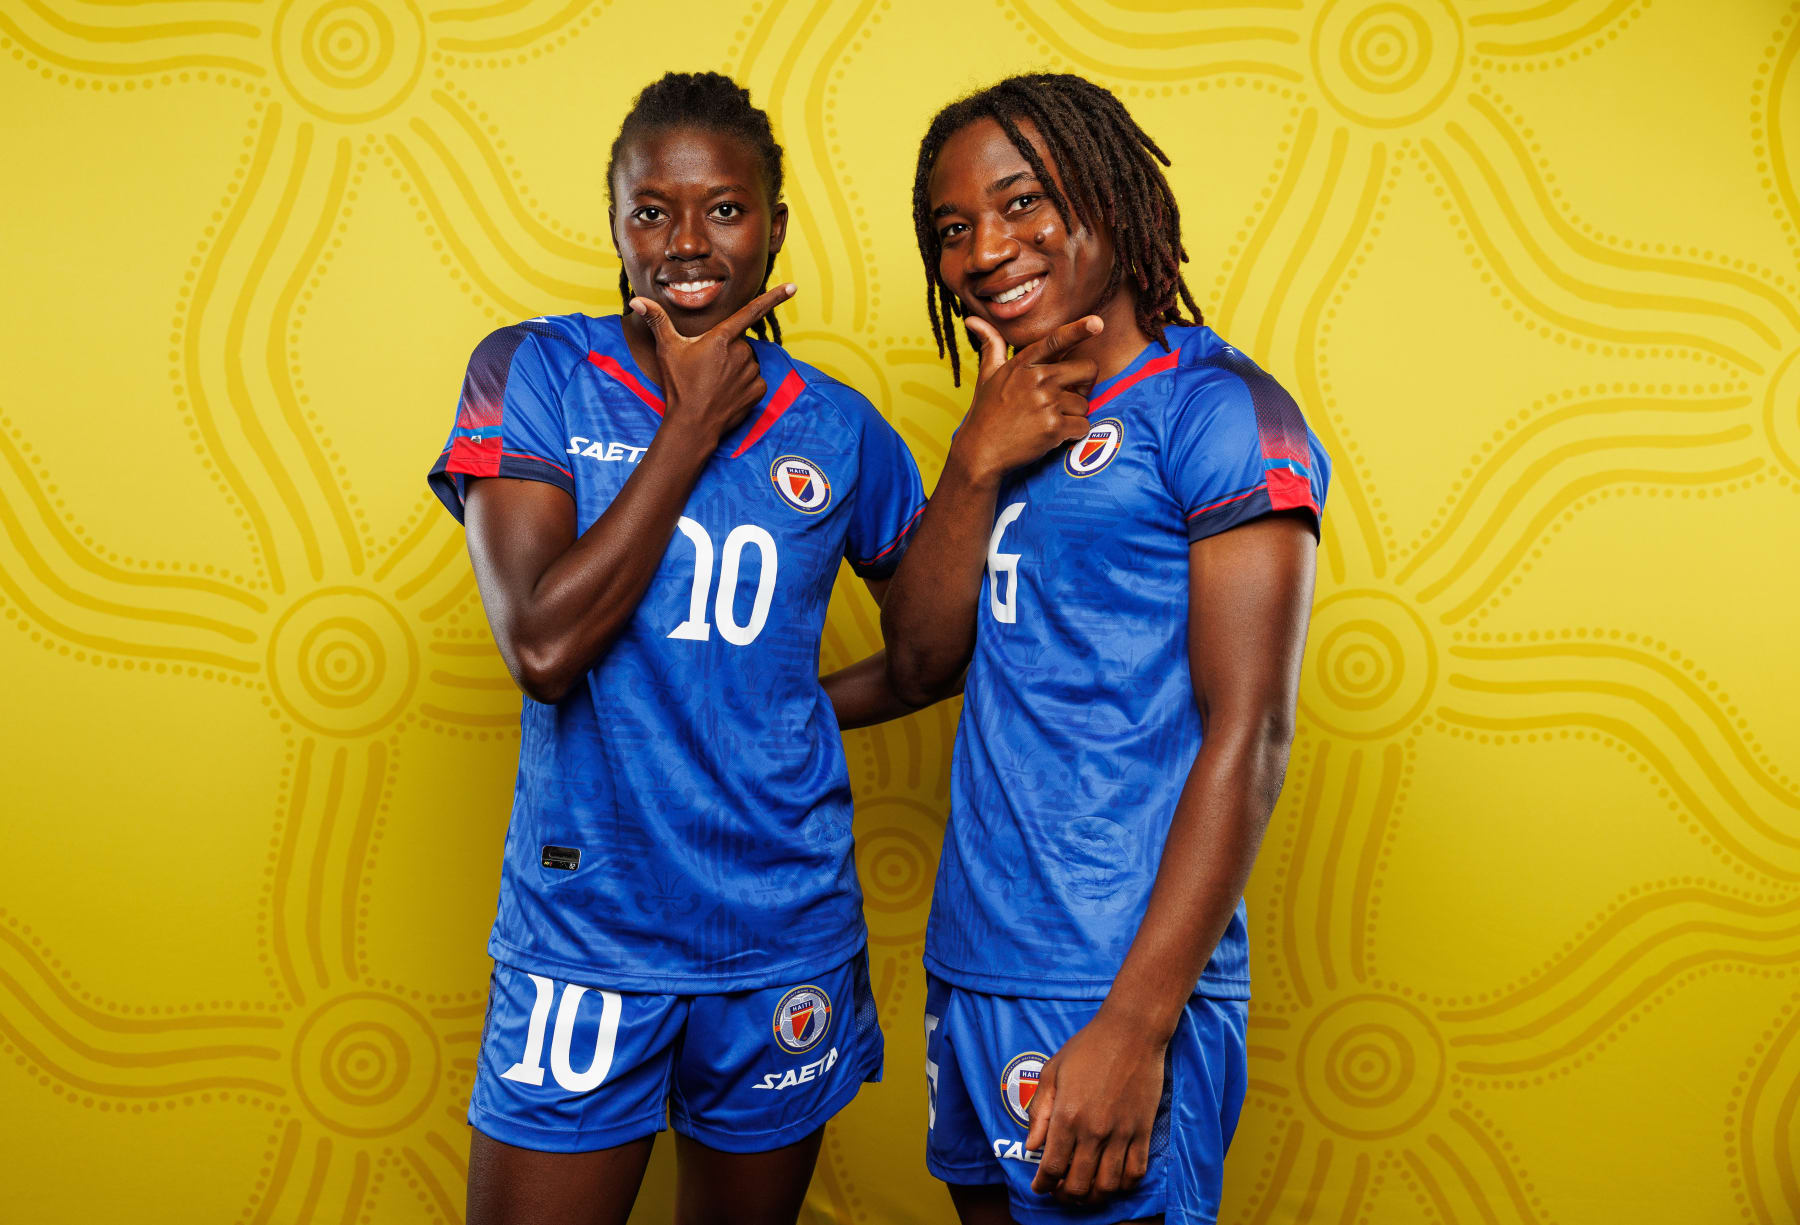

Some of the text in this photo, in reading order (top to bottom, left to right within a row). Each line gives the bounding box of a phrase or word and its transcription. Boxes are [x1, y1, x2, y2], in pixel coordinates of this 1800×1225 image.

[566, 436, 649, 464] SAET
[666, 515, 778, 646] 10
[987, 502, 1027, 624] 6
[792, 1001, 811, 1012] HAITI
[500, 973, 622, 1092] 10
[751, 1046, 838, 1090] SAETA
[993, 1138, 1045, 1164] SAE
